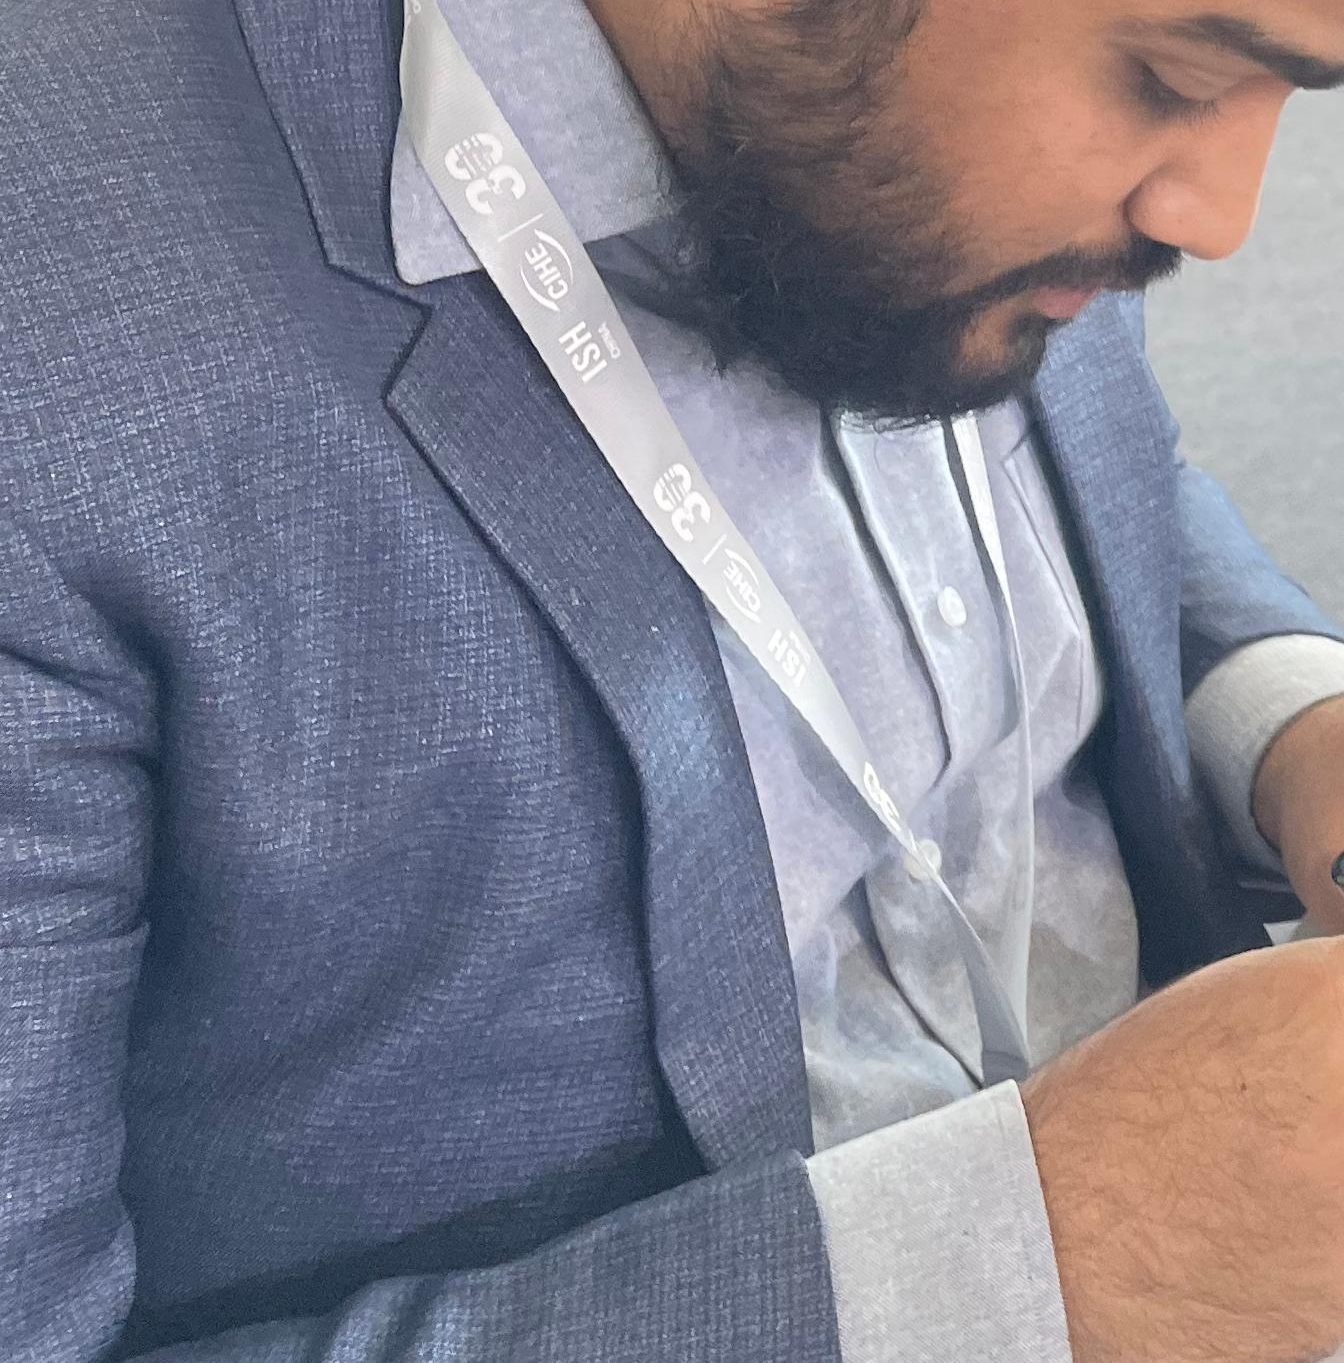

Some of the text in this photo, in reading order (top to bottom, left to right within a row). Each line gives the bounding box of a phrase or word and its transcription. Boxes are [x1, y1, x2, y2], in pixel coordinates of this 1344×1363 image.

[525, 243, 568, 300] CIHE
[558, 321, 608, 383] ISH
[723, 560, 761, 611] CIHE
[768, 629, 806, 685] ISH
